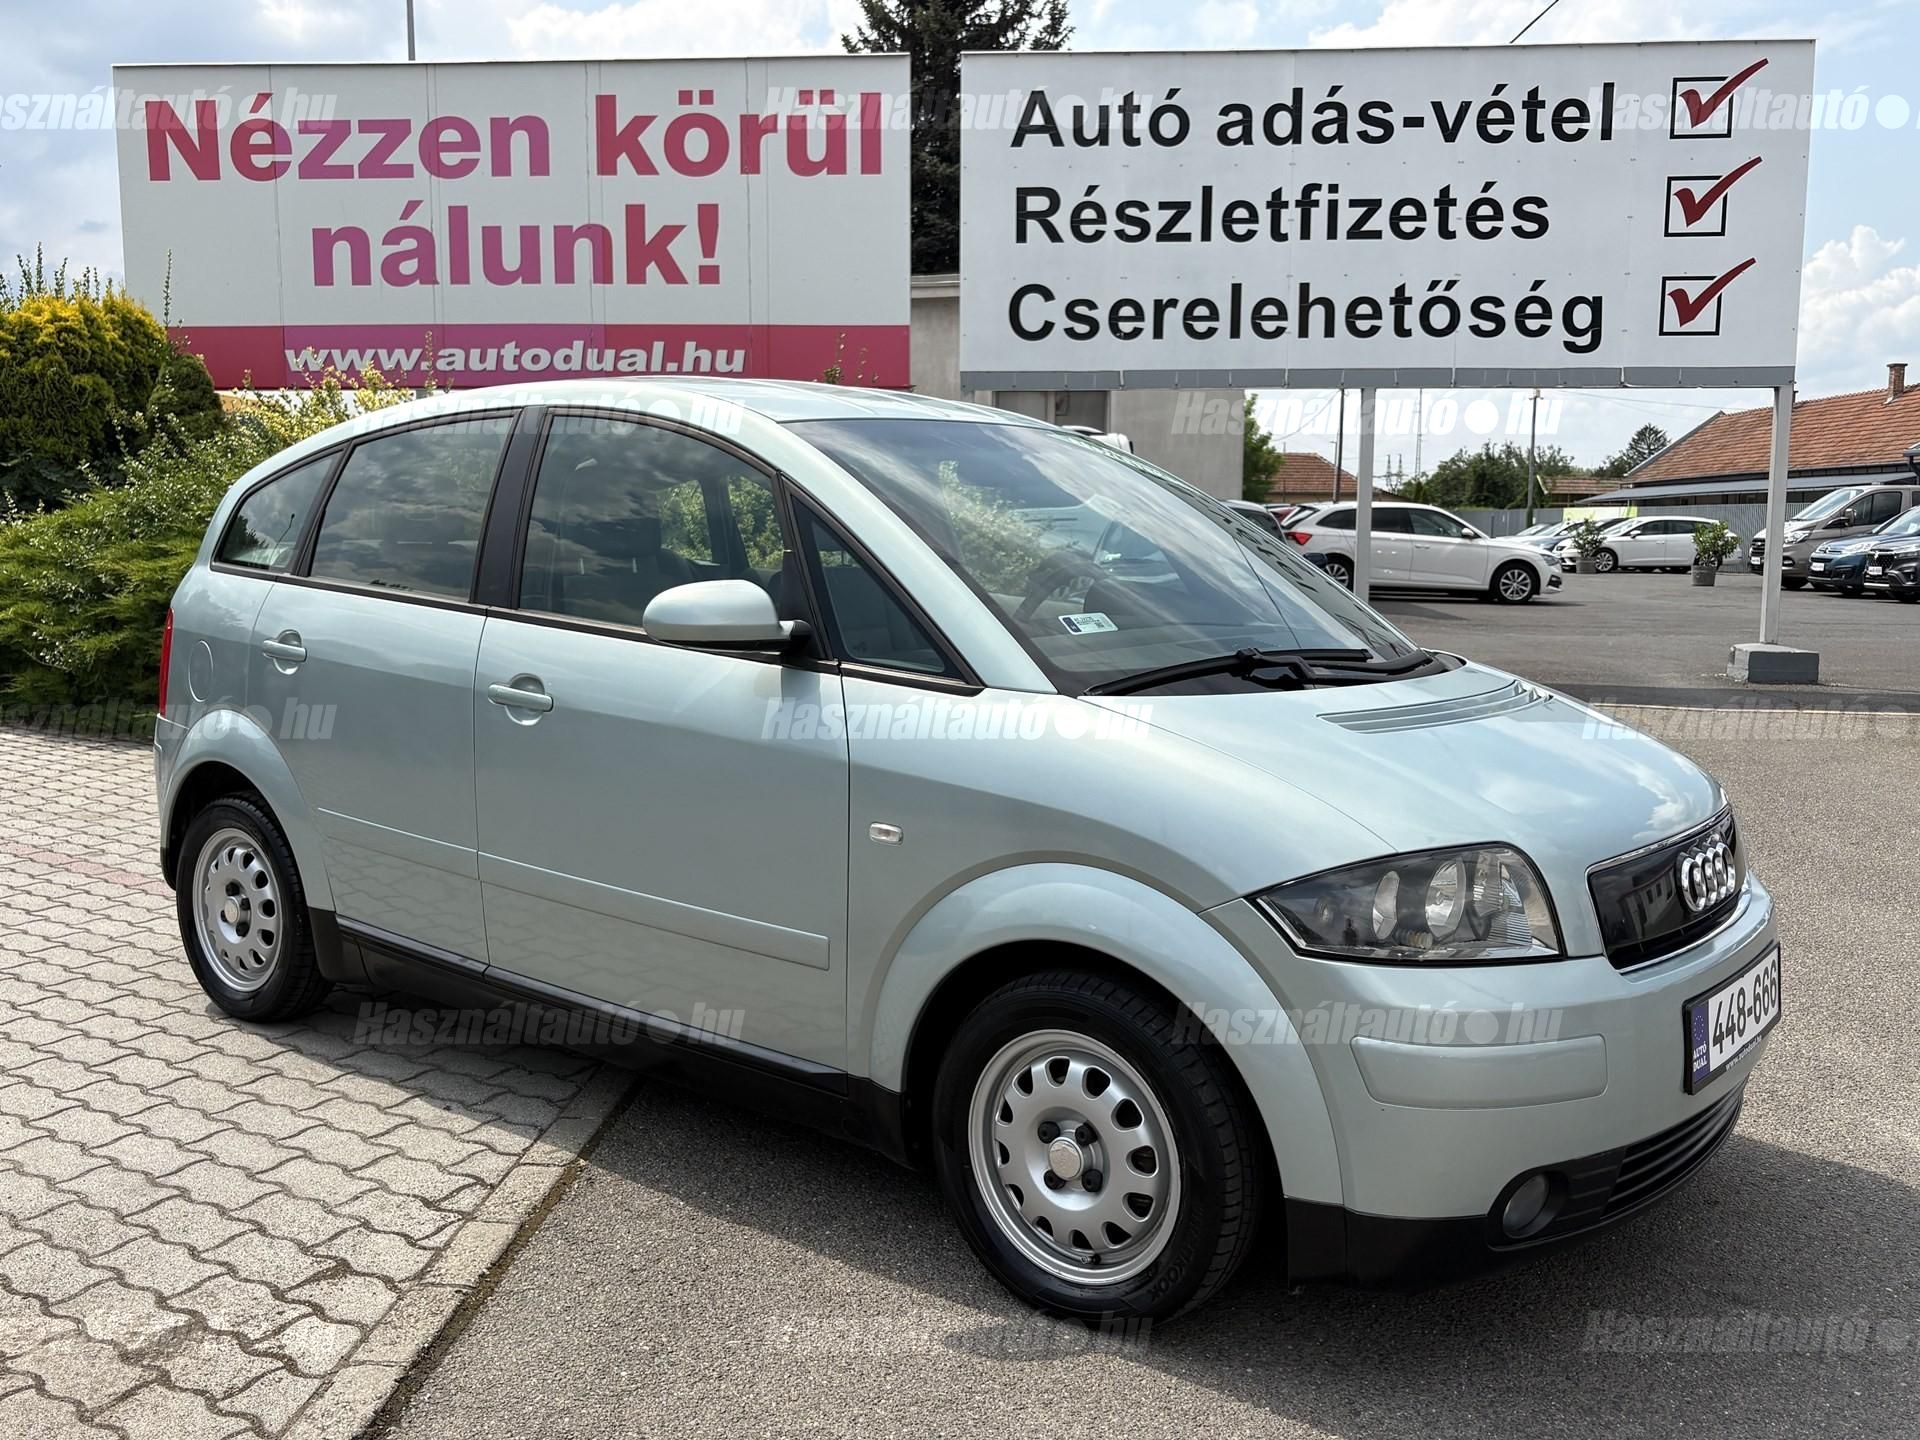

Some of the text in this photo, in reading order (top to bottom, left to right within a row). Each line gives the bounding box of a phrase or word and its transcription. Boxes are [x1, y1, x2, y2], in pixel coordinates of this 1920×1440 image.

[145, 89, 881, 182] Nézzen körül
[1010, 82, 1615, 148] Autó adás-vétel
[312, 200, 720, 287] nálunk!
[1015, 181, 1550, 244] Részletfizetés
[1008, 279, 1603, 354] Cserelehetőség
[285, 340, 745, 374] www.autodual.hu
[1711, 959, 1777, 1055] 448-666
[1693, 1041, 1707, 1060] AUTÓ
[1693, 1056, 1707, 1072] DUAL
